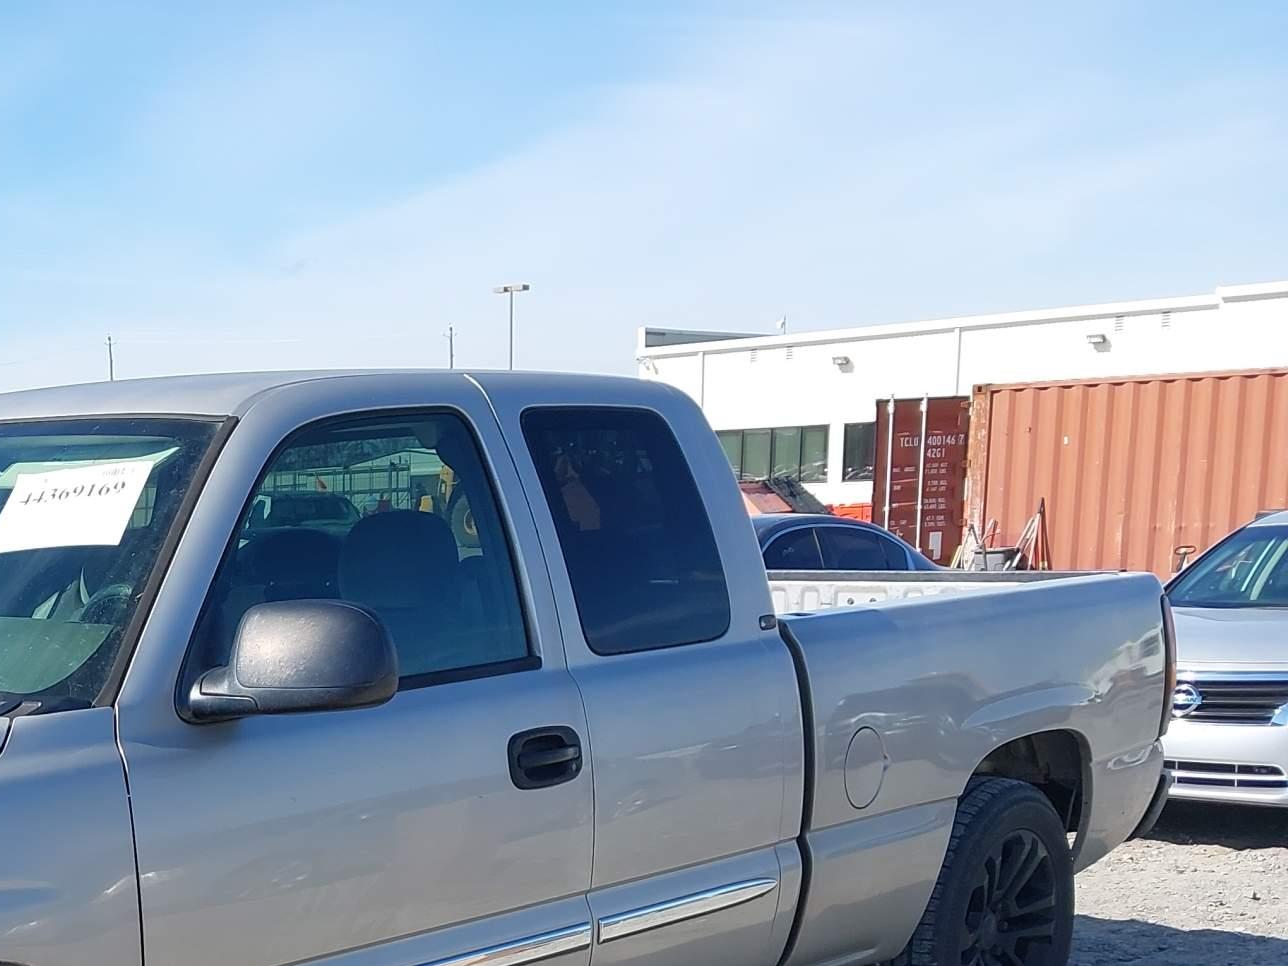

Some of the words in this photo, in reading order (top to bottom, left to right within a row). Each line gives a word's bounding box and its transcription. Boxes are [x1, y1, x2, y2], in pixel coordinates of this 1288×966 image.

[899, 436, 919, 448] TCLU
[927, 434, 956, 446] 400146
[19, 481, 126, 506] 44369169
